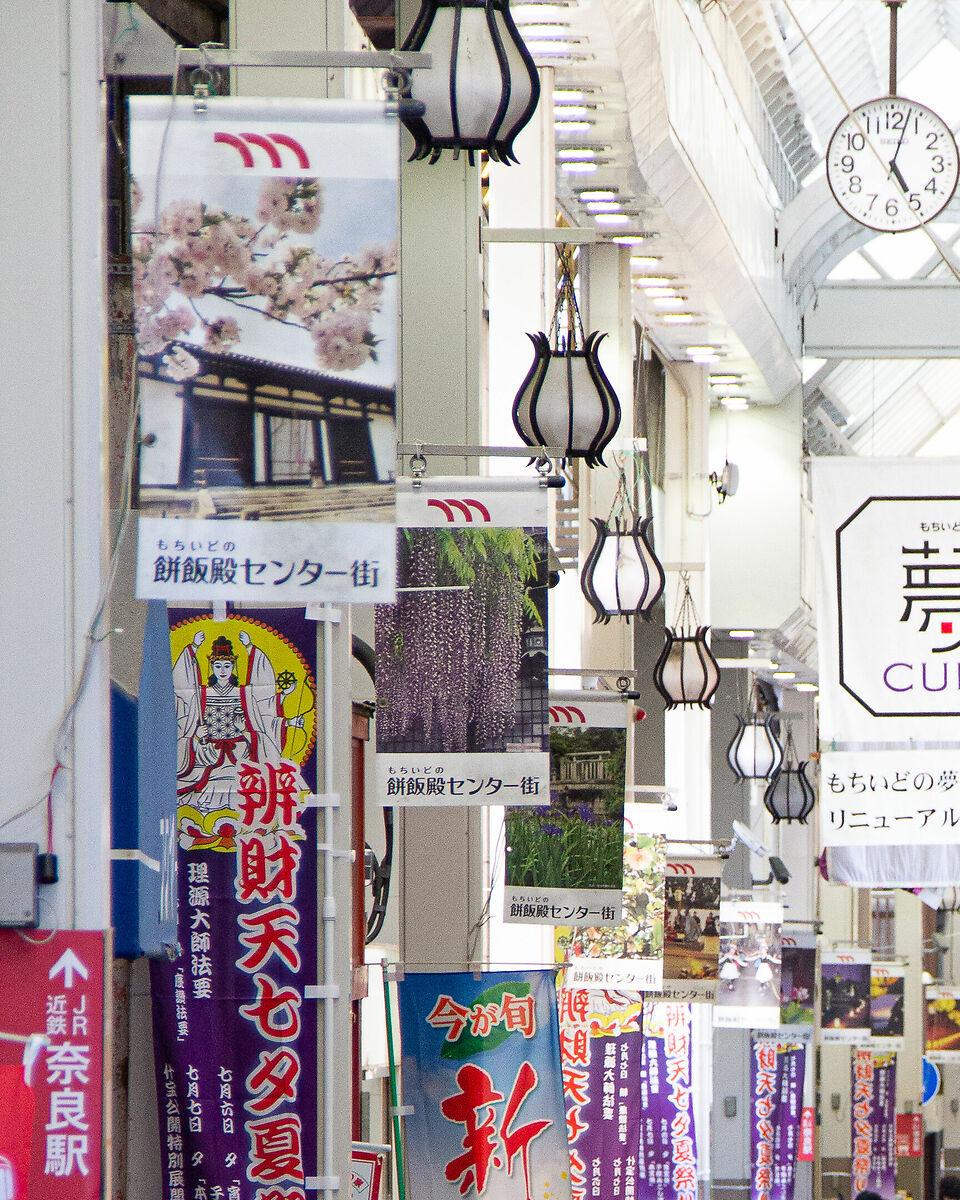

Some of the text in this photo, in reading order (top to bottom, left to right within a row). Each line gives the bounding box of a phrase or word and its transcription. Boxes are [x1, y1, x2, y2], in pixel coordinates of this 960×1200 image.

[866, 116, 880, 135] 11
[886, 111, 904, 130] 12
[914, 116, 919, 135] 1
[847, 132, 866, 151] 10
[925, 132, 939, 150] 2
[840, 155, 855, 173] 9
[930, 155, 945, 173] 3
[848, 175, 862, 194] 8
[924, 177, 938, 195] 4
[865, 193, 879, 211] 7
[884, 198, 899, 217] 6
[908, 193, 922, 211] 5
[156, 539, 236, 552] もちいどの
[152, 556, 380, 589] 餅飯殿センター街
[387, 765, 444, 775] もちいどの
[386, 776, 541, 797] 餅飯殿センター街
[509, 903, 616, 921] 餅飯殿センター街
[45, 994, 68, 1036] 近鉄
[426, 991, 539, 1043] 今が旬
[43, 1041, 91, 1178] 奈良駅
